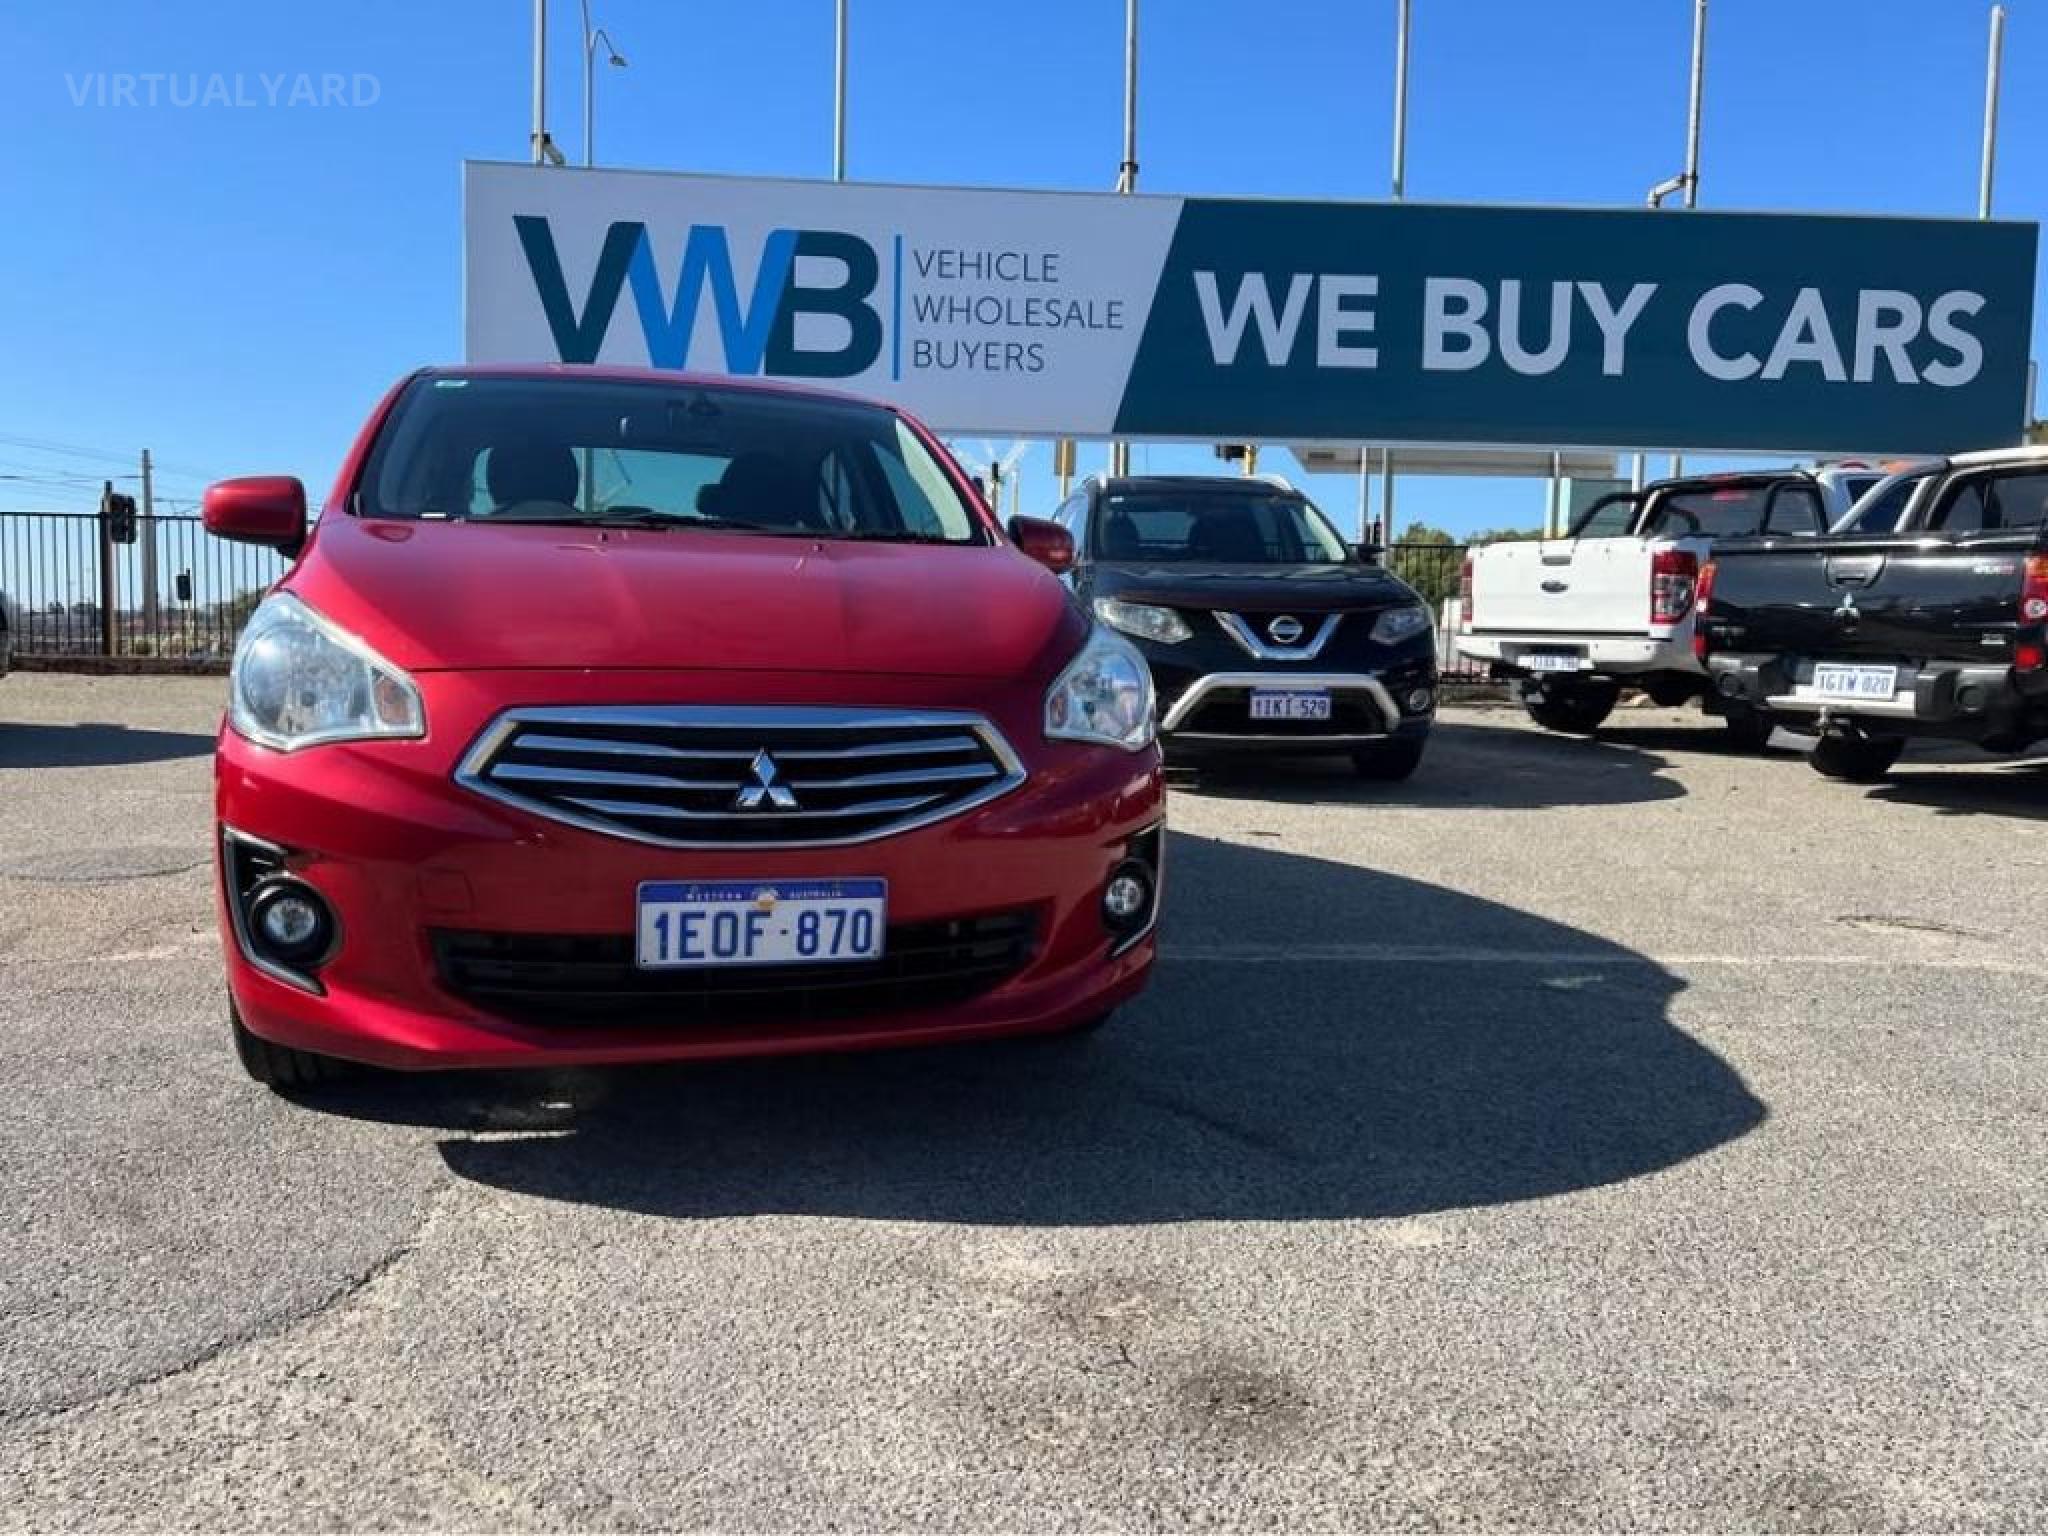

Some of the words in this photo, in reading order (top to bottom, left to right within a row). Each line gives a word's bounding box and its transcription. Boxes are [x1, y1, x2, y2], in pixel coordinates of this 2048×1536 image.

[913, 249, 1060, 283] VEHICLE
[913, 293, 1124, 331] WHOLESALE
[1193, 271, 1379, 369] WE
[1421, 276, 1659, 376] BUY
[1687, 282, 1987, 388] CARS
[913, 340, 1046, 373] BUYERS
